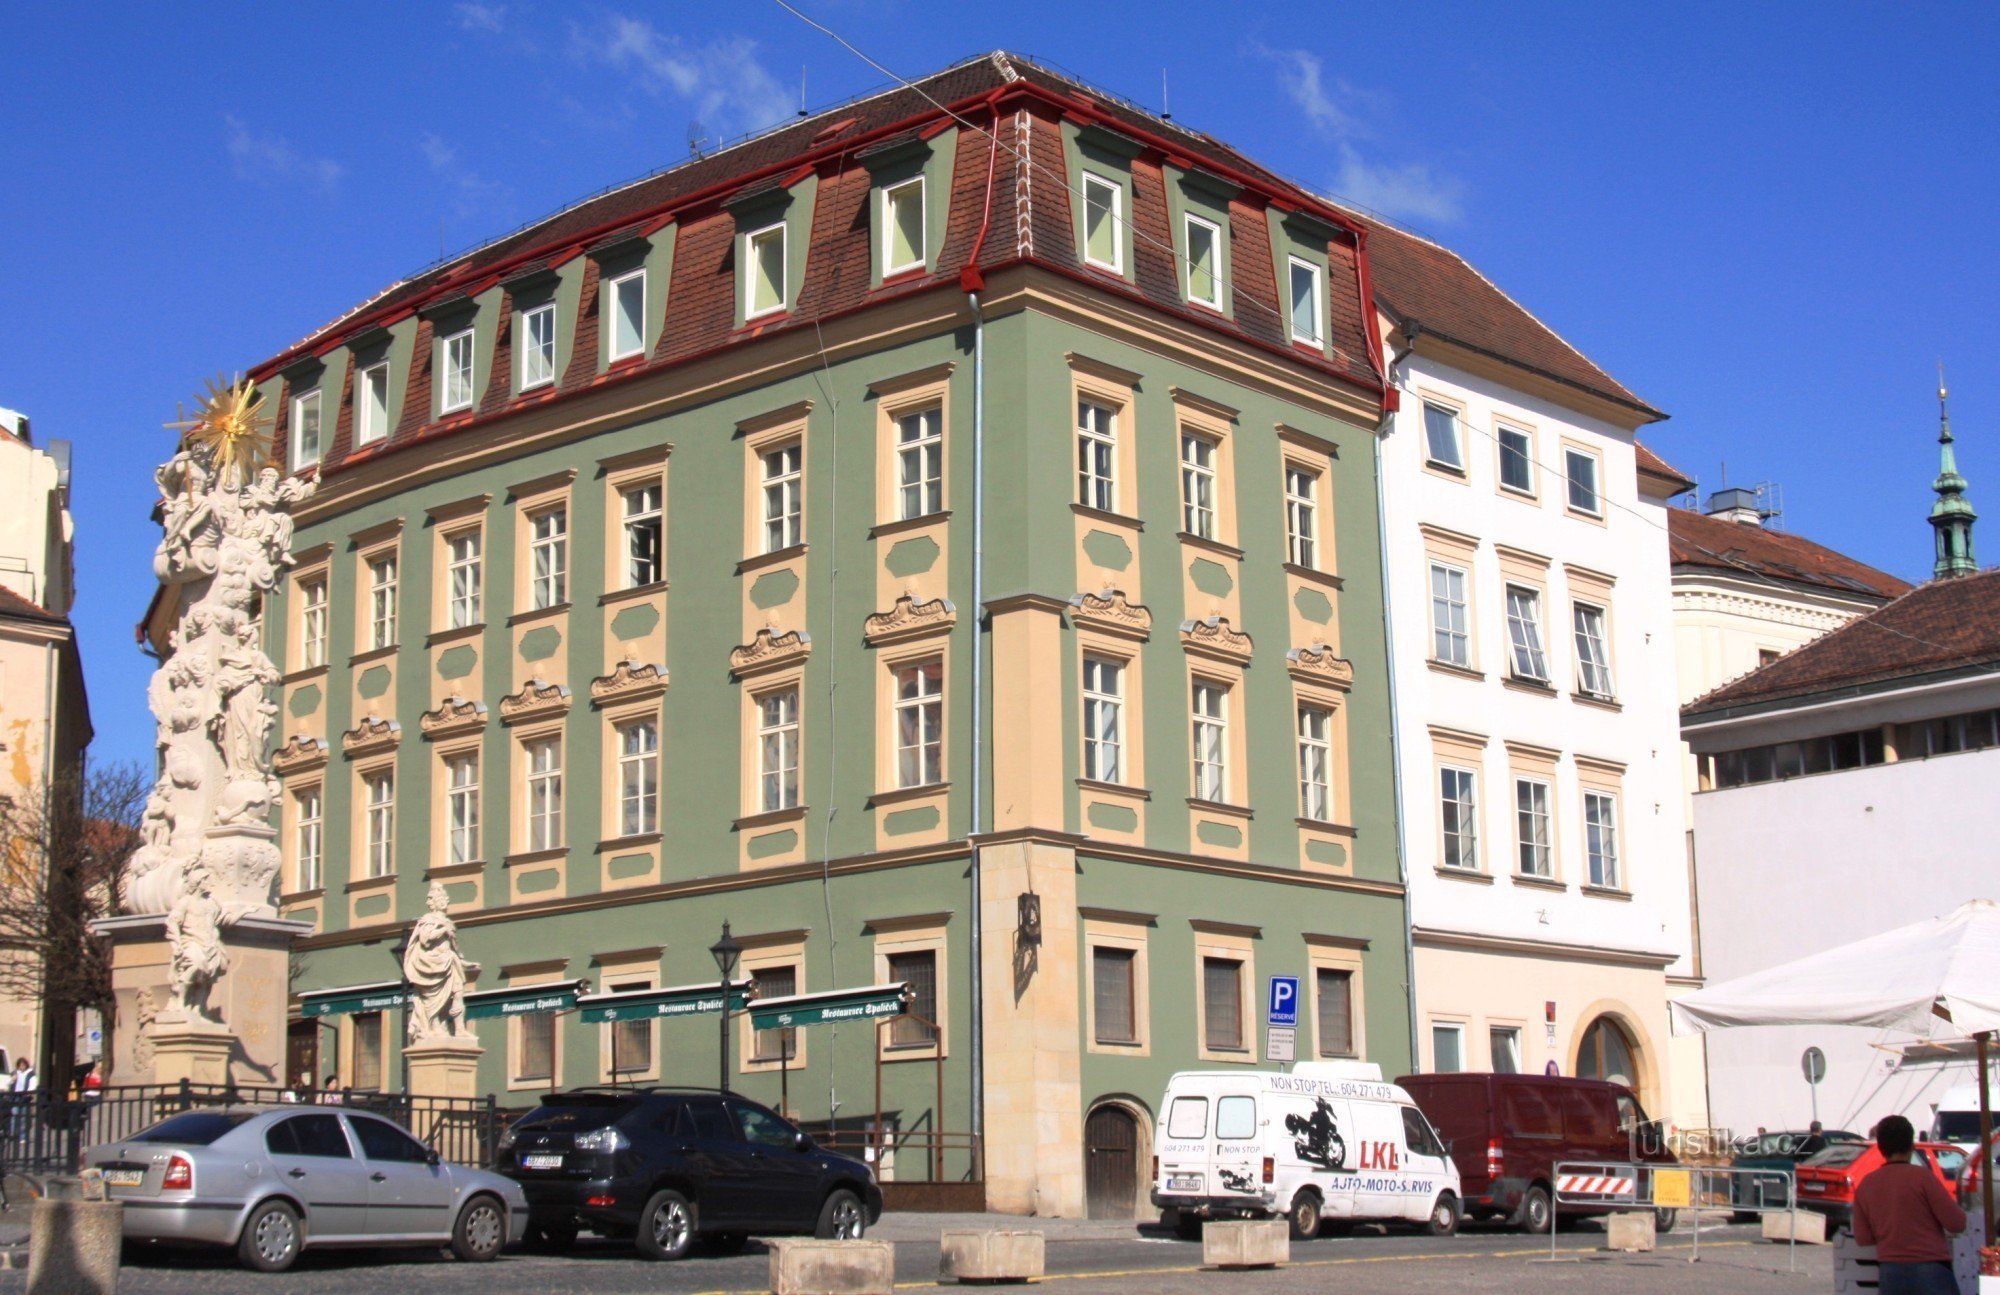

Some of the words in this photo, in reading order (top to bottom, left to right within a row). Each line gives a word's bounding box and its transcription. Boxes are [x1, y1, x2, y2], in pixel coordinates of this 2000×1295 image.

[1274, 982, 1293, 1010] P
[502, 1001, 536, 1012] Restaurace
[658, 1003, 696, 1014] Restaurace
[821, 1007, 864, 1019] Restaurace
[1270, 1077, 1292, 1090] NON
[1294, 1078, 1317, 1093] STOP
[1341, 1082, 1357, 1096] 604
[1359, 1084, 1374, 1097] 271
[1376, 1085, 1392, 1099] 479
[1164, 1144, 1177, 1152] 604
[1178, 1144, 1190, 1152] 271
[1359, 1140, 1399, 1171] LKL
